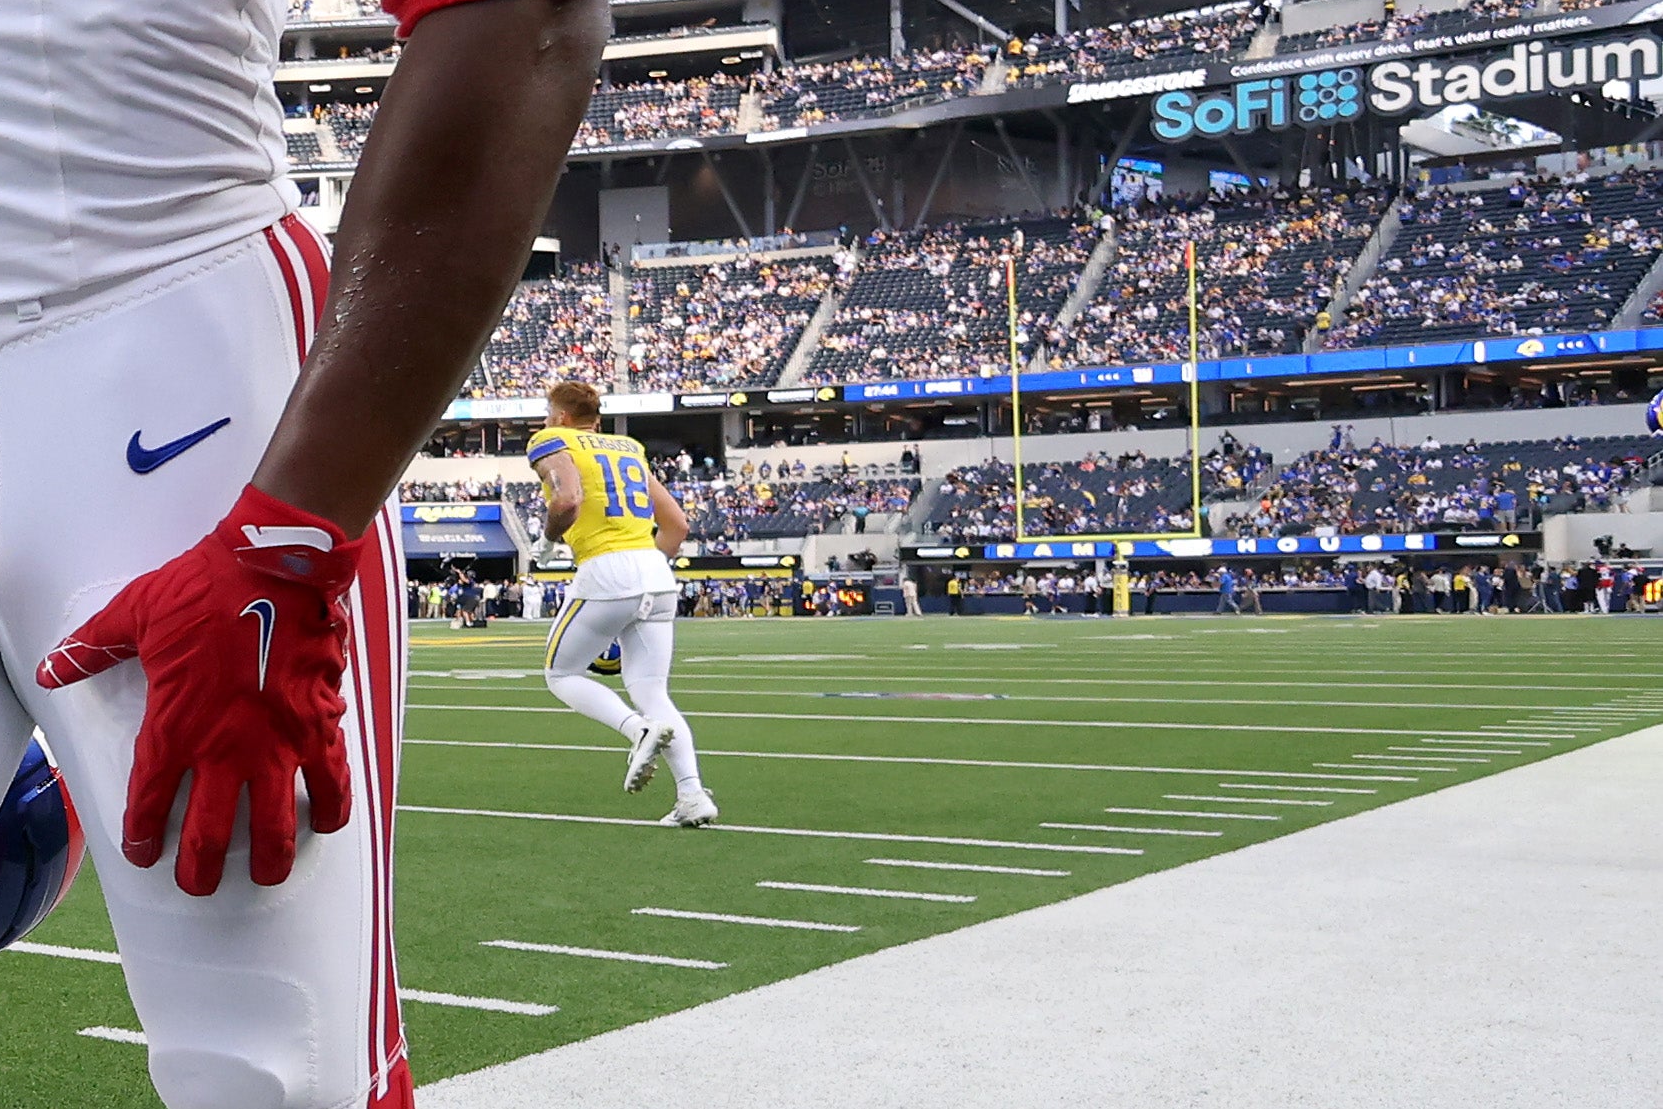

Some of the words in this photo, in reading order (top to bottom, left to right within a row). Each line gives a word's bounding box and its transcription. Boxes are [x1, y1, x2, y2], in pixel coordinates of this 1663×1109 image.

[1231, 56, 1302, 77] Confidence
[1304, 52, 1334, 67] with
[1336, 47, 1372, 63] every
[1374, 41, 1411, 57] drive,
[1414, 35, 1451, 50] that's
[1454, 30, 1491, 45] what
[1493, 24, 1531, 41] really
[1534, 16, 1592, 34] matters.
[1067, 69, 1207, 103] BRIDGESTONE
[1155, 80, 1284, 138] SoFi
[1370, 37, 1659, 111] Stadium
[413, 506, 477, 522] RAMS
[594, 454, 654, 519] 18
